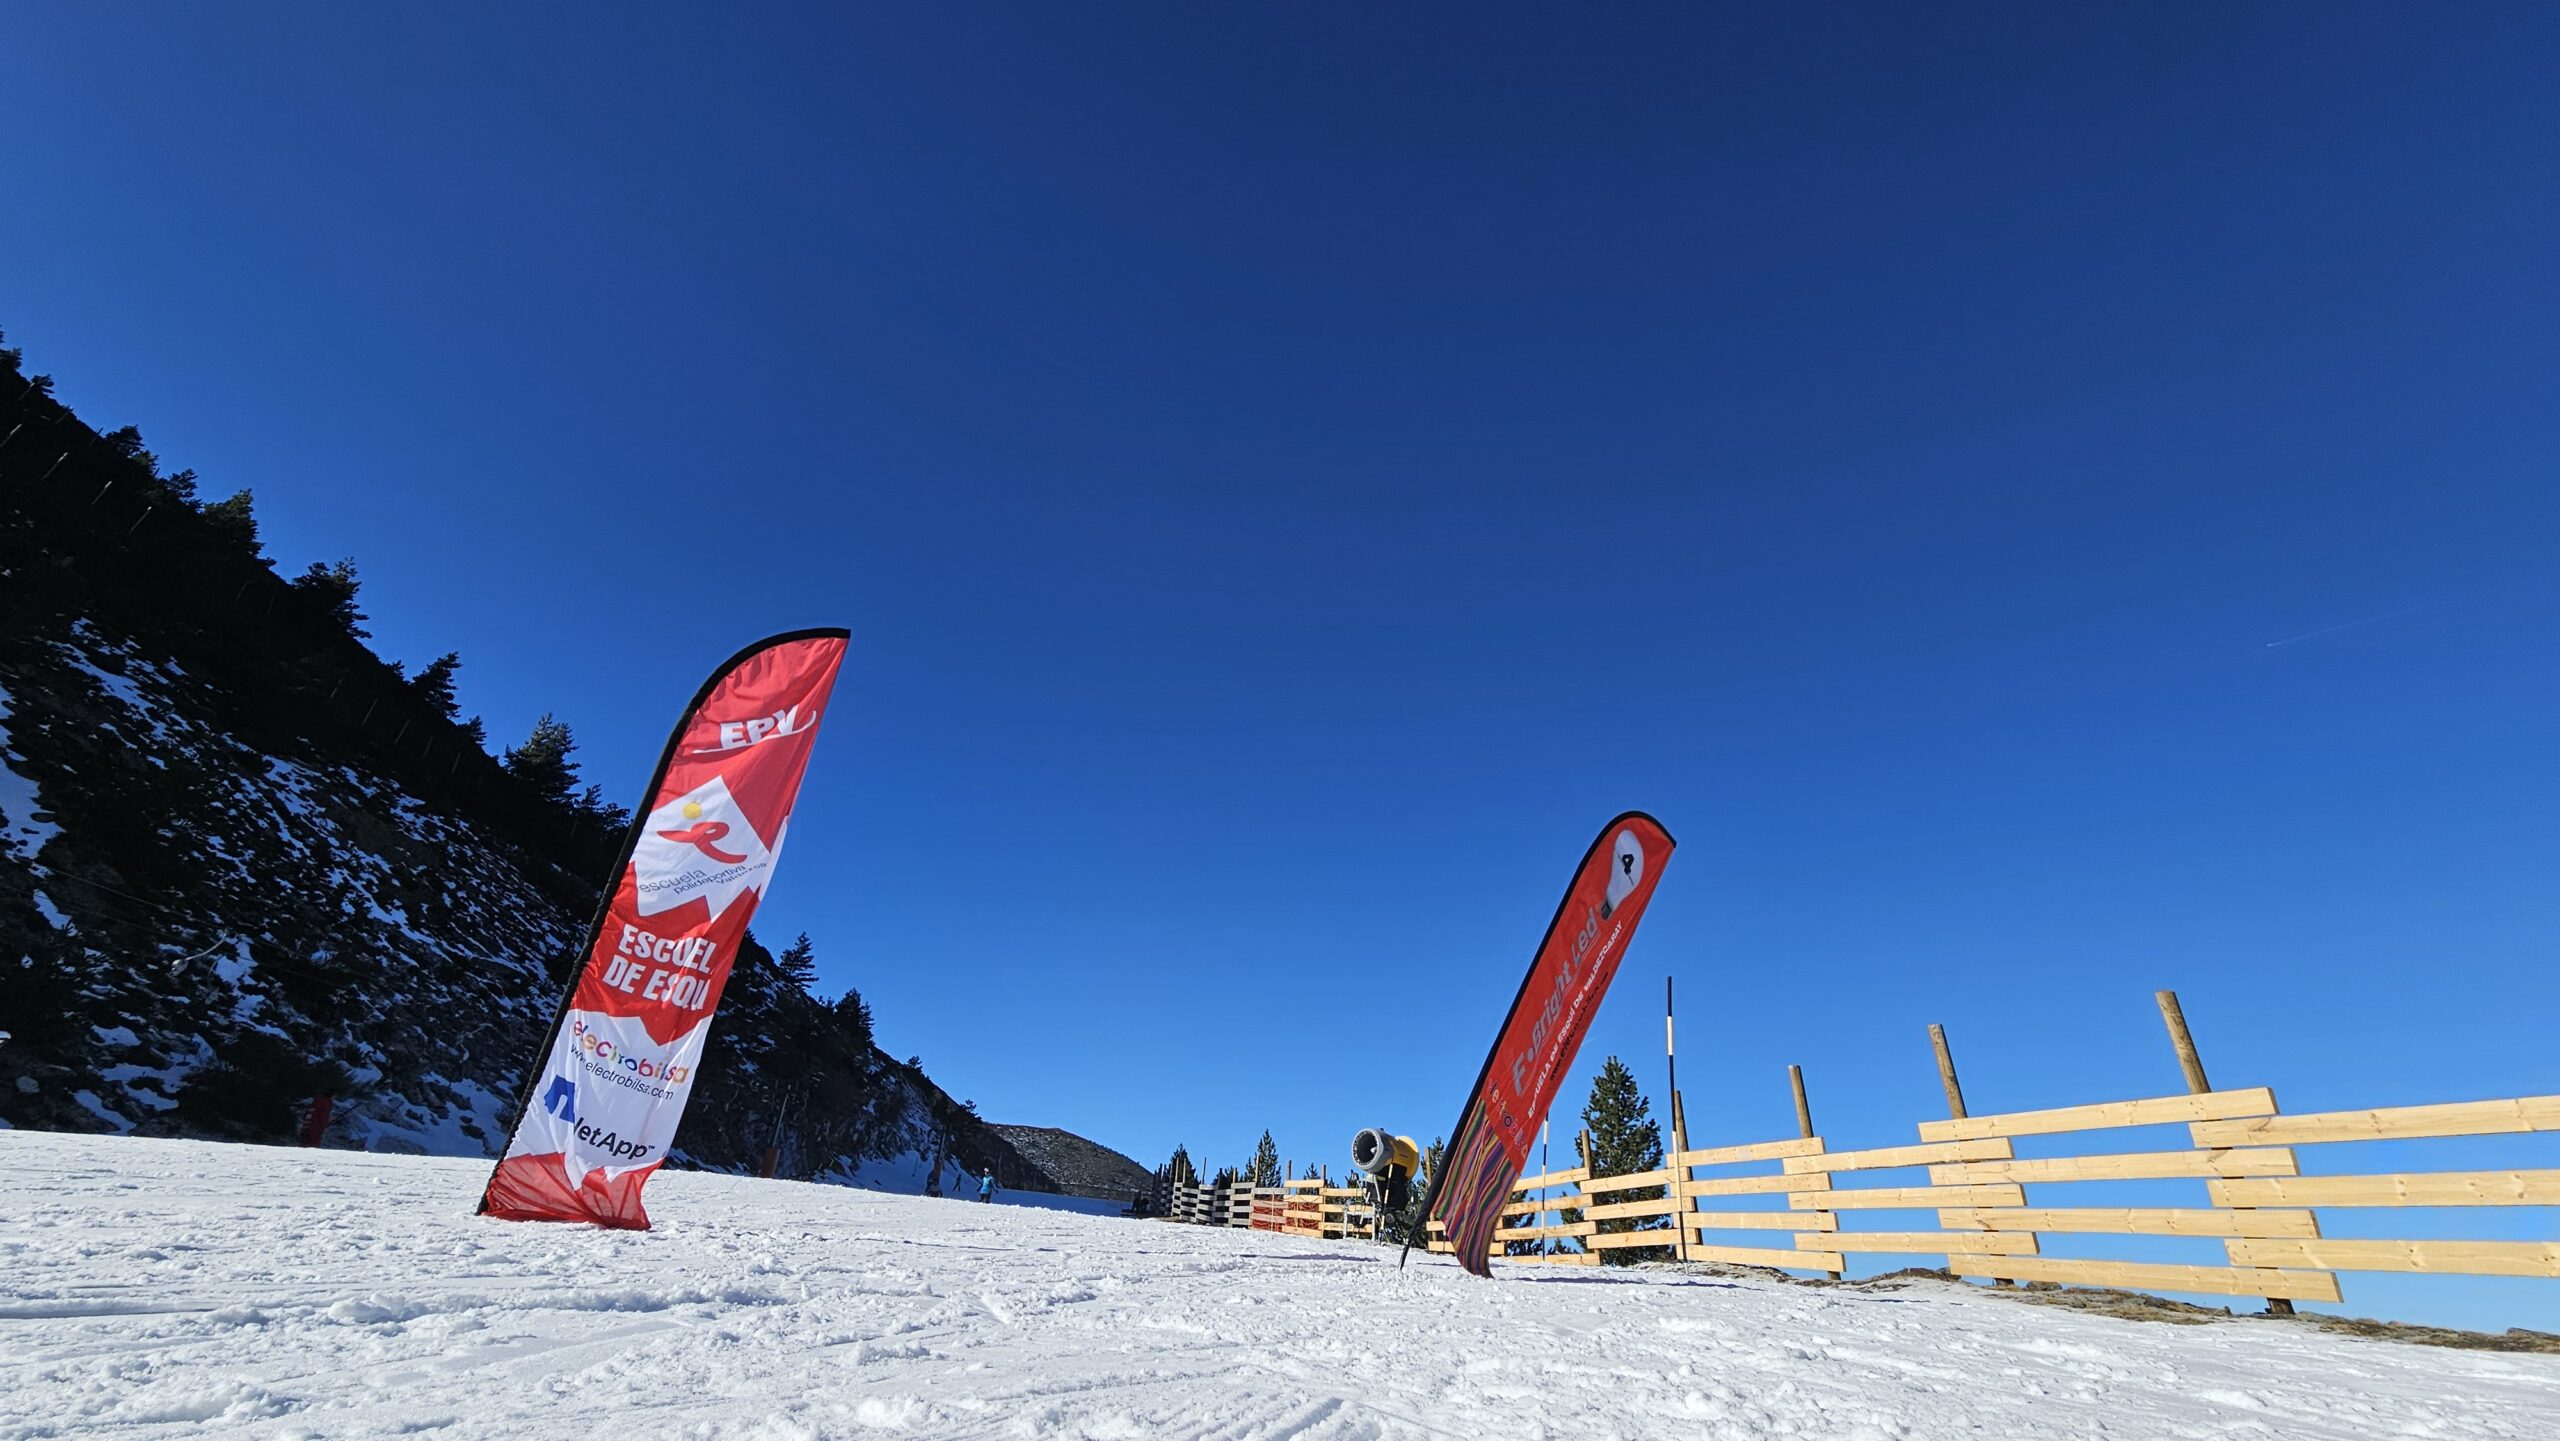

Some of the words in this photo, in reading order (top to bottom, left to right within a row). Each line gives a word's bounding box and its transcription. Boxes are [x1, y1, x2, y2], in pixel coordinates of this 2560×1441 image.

[720, 704, 800, 750] EPV
[639, 868, 707, 893] escuela
[673, 864, 746, 895] polideportiva
[619, 923, 717, 974] ESCUEL
[602, 954, 646, 994] DE
[1528, 1062, 1551, 1118] ESUELA
[1573, 991, 1584, 1009] DE
